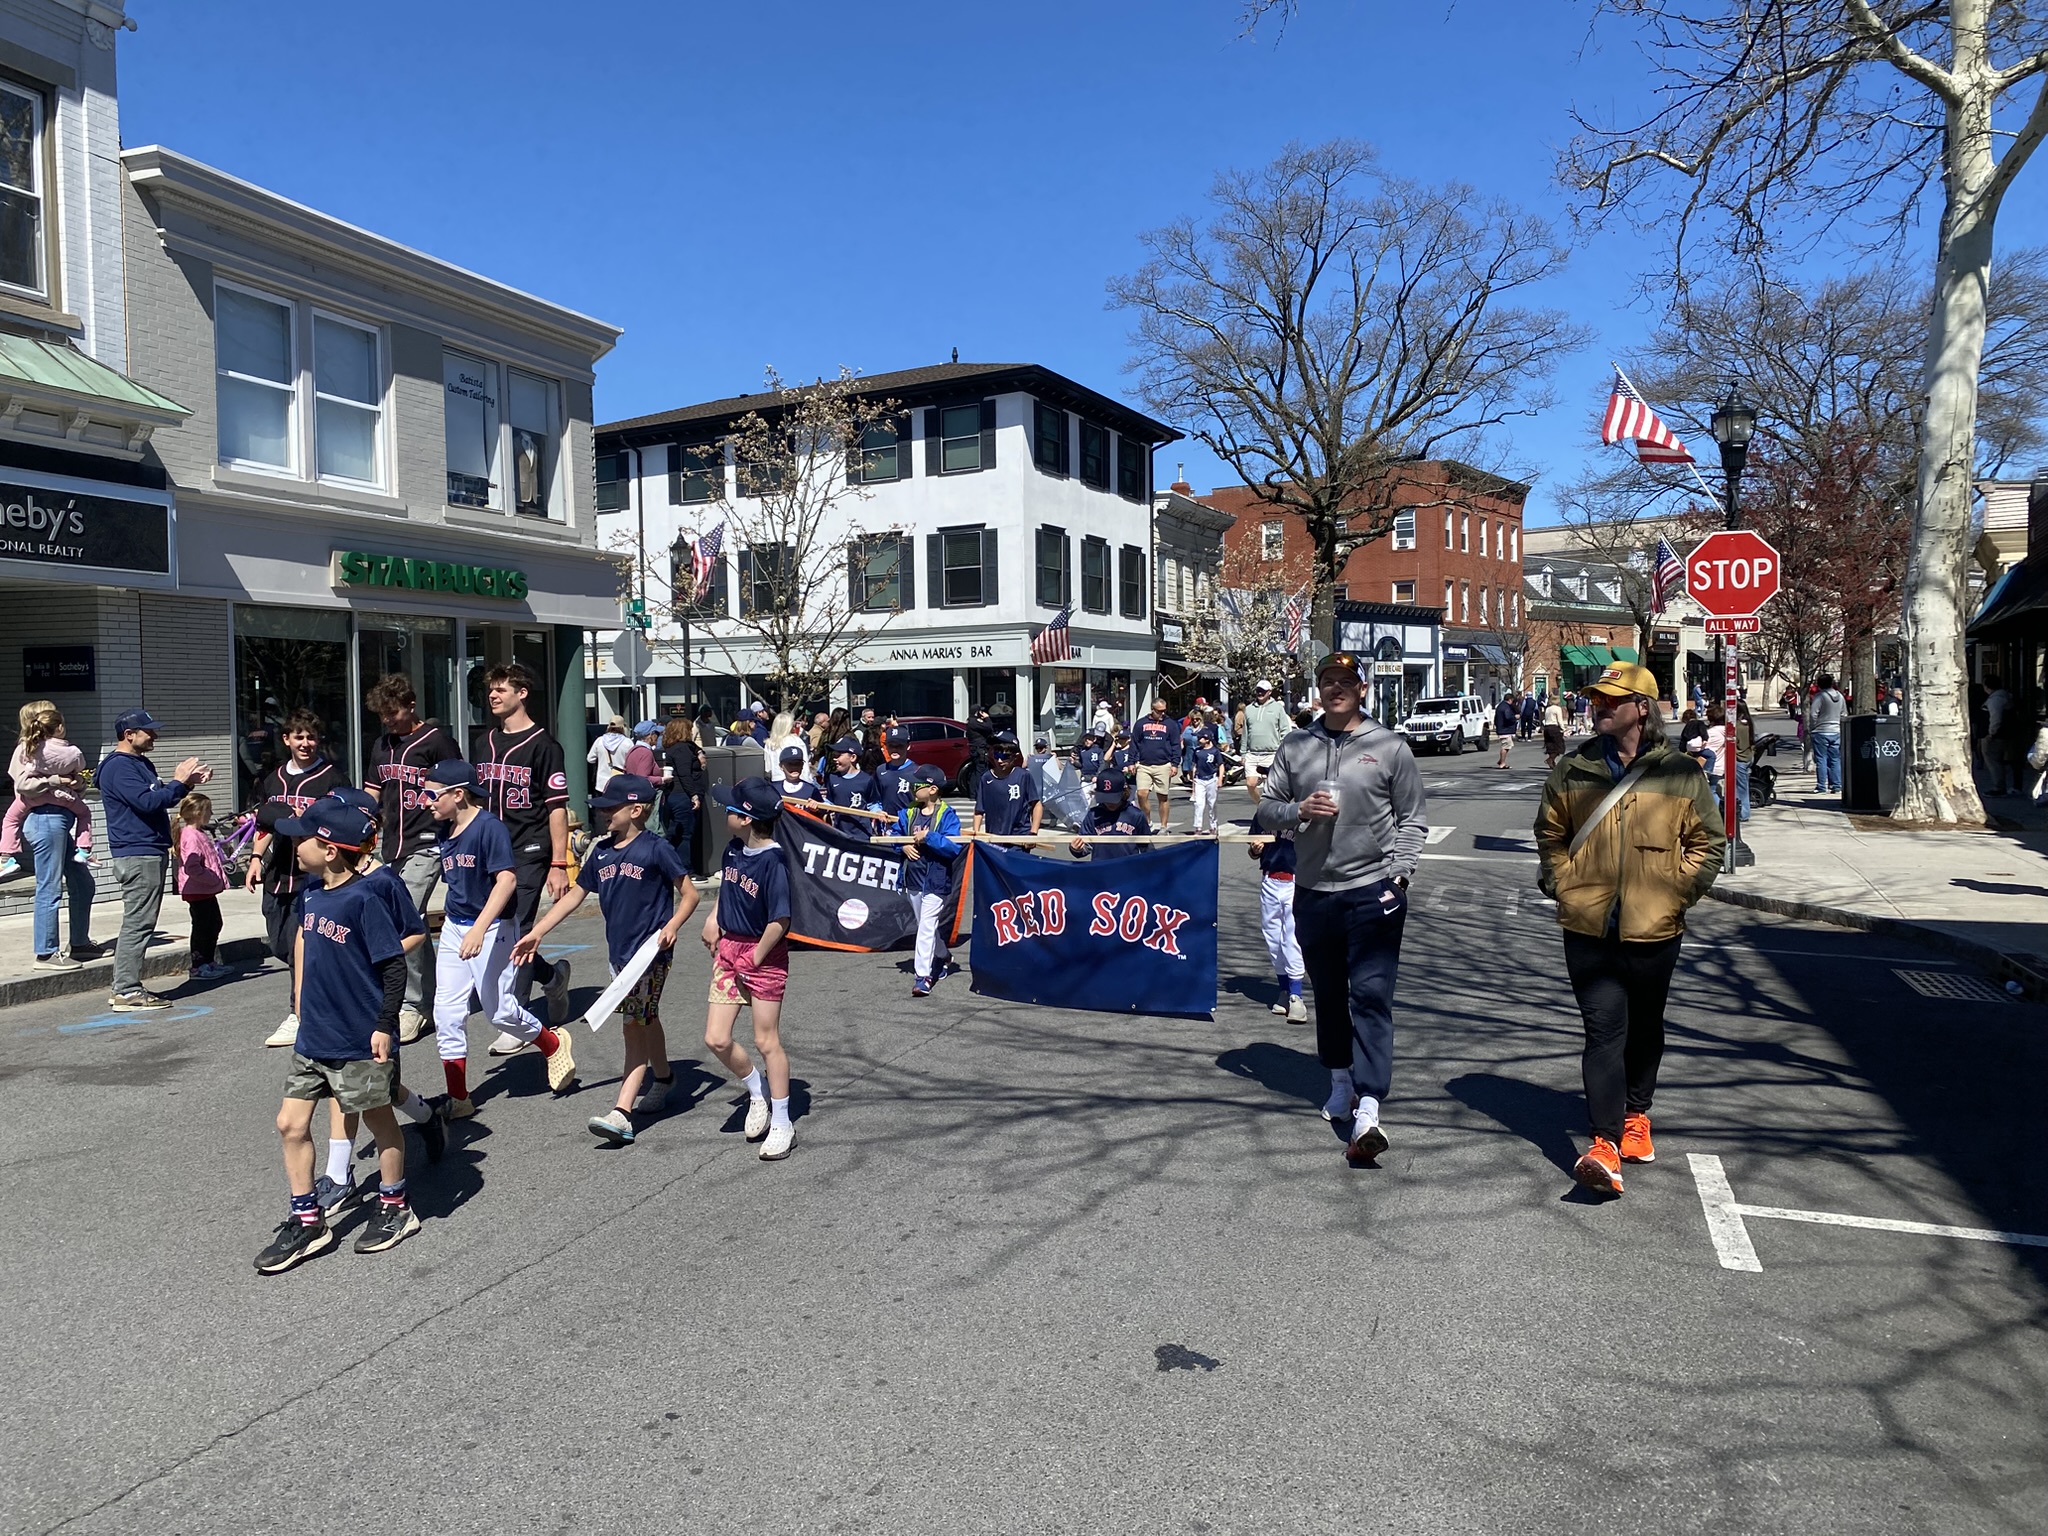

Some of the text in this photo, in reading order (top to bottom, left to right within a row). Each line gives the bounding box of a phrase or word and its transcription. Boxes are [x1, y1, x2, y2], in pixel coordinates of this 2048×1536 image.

[459, 373, 483, 389] Batista
[447, 382, 495, 409] Custom Tailoring
[38, 542, 84, 558] REALTY
[340, 551, 530, 600] STARBUCKS
[1692, 557, 1773, 591] STOP
[1709, 619, 1755, 631] ALL WAY
[889, 645, 993, 661] ANNA MARIA'S BAR
[1071, 647, 1082, 659] BAR
[58, 661, 90, 672] Sotheby's
[1103, 779, 1112, 791] B
[403, 789, 430, 811] 34
[506, 787, 533, 810] 21
[598, 861, 645, 883] RED SOX
[802, 842, 903, 892] TIGER
[739, 873, 760, 899] SOX
[316, 916, 351, 944] SOX
[990, 888, 1067, 946] RED
[1089, 891, 1190, 955] SOX
